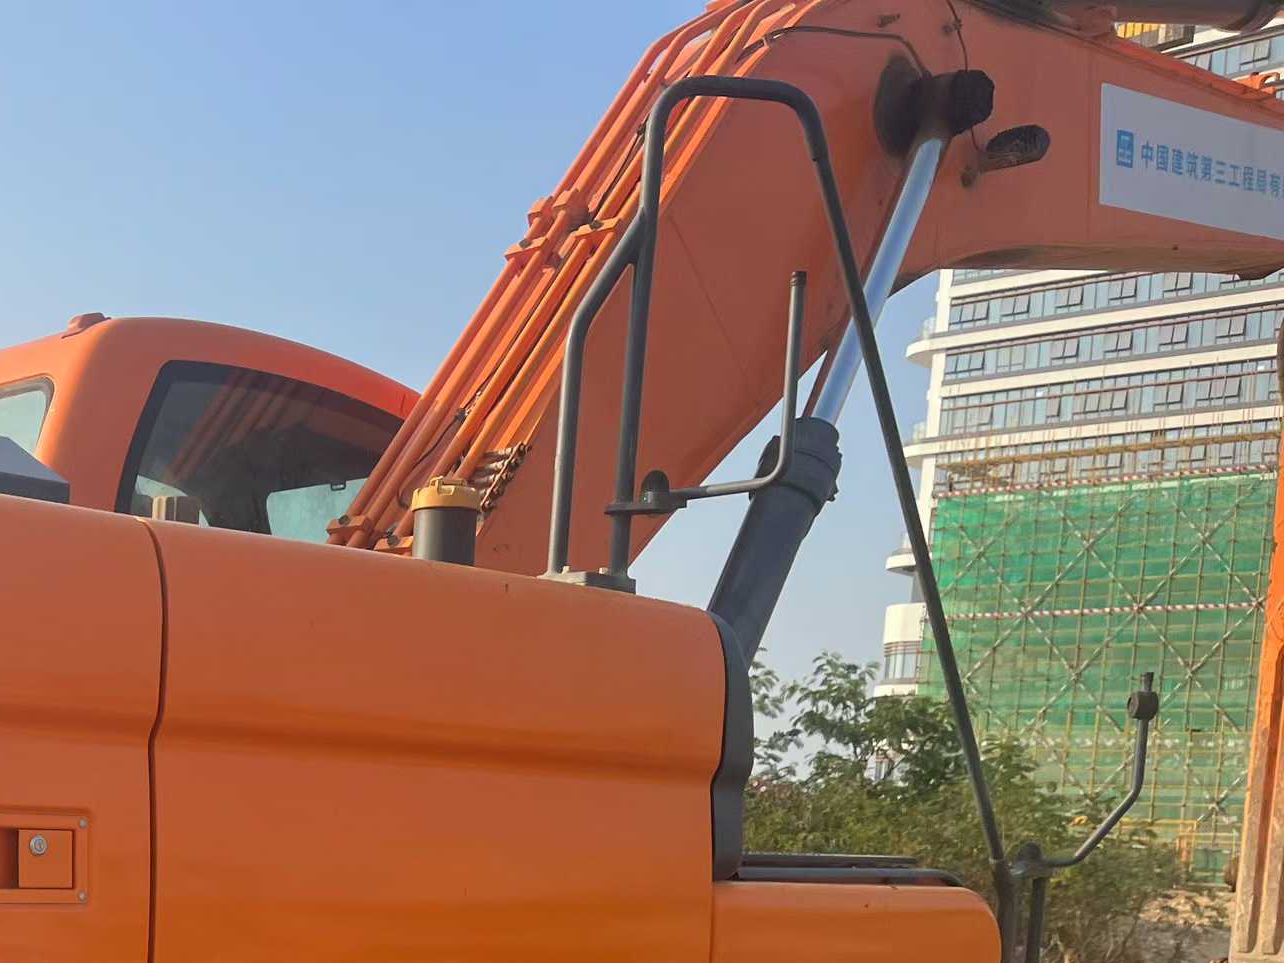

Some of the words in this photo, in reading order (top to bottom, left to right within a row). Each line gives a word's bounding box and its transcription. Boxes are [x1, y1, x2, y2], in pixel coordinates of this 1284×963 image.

[1141, 141, 1284, 198] 中国建筑第三工程局有
